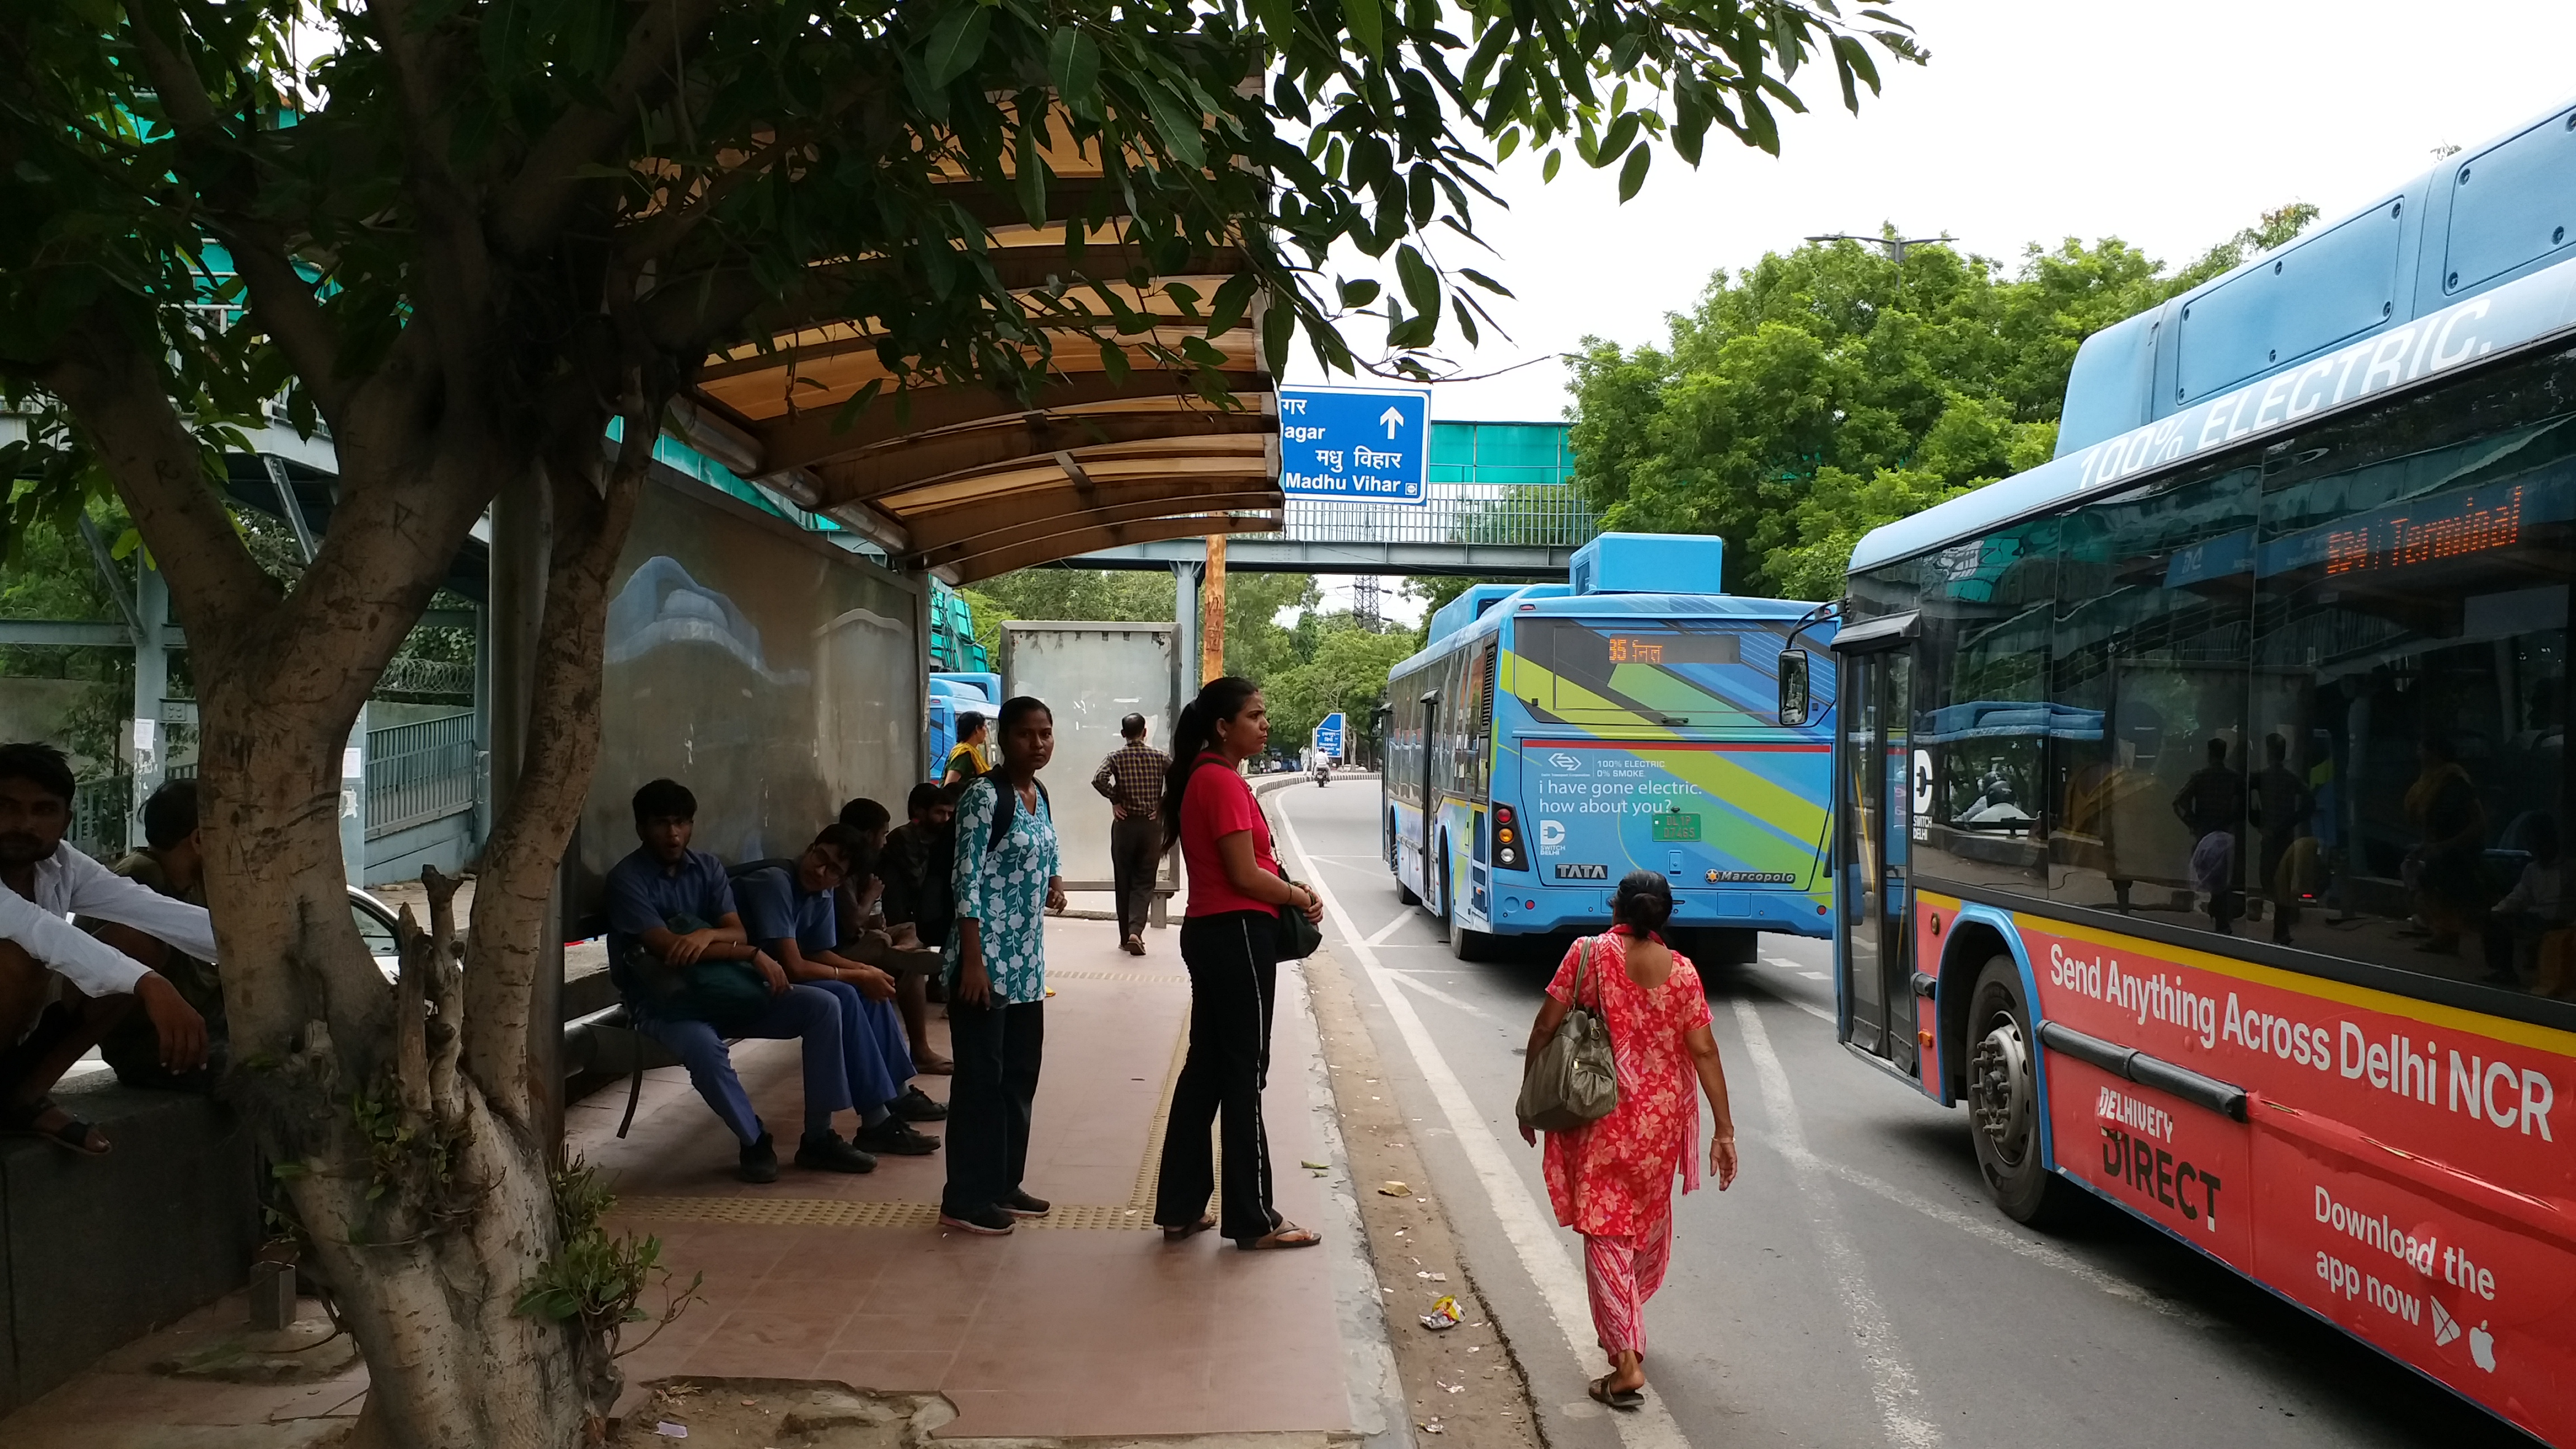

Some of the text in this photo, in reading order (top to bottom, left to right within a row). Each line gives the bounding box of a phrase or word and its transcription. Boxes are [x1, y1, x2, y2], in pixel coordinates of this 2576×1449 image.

[2078, 298, 2492, 490] 100% ELECTRIC.
[1281, 399, 1308, 415] गर
[1281, 423, 1325, 443] agar
[1315, 445, 1402, 473] मधु विहार
[1286, 472, 1401, 492] Madhu Vihar
[2390, 485, 2523, 566] Terminal
[1539, 779, 1702, 798] i have gone electric.
[1539, 798, 1672, 816] how about you?
[1913, 815, 1933, 828] SWITCH
[1912, 827, 1928, 841] DELHI
[1557, 864, 1606, 878] TATA
[1721, 871, 1795, 883] Marcopolo
[2051, 943, 2554, 1143] Send Anything Across Delhi NCR
[2315, 1184, 2496, 1301] Download the
[2316, 1250, 2421, 1327] app now
